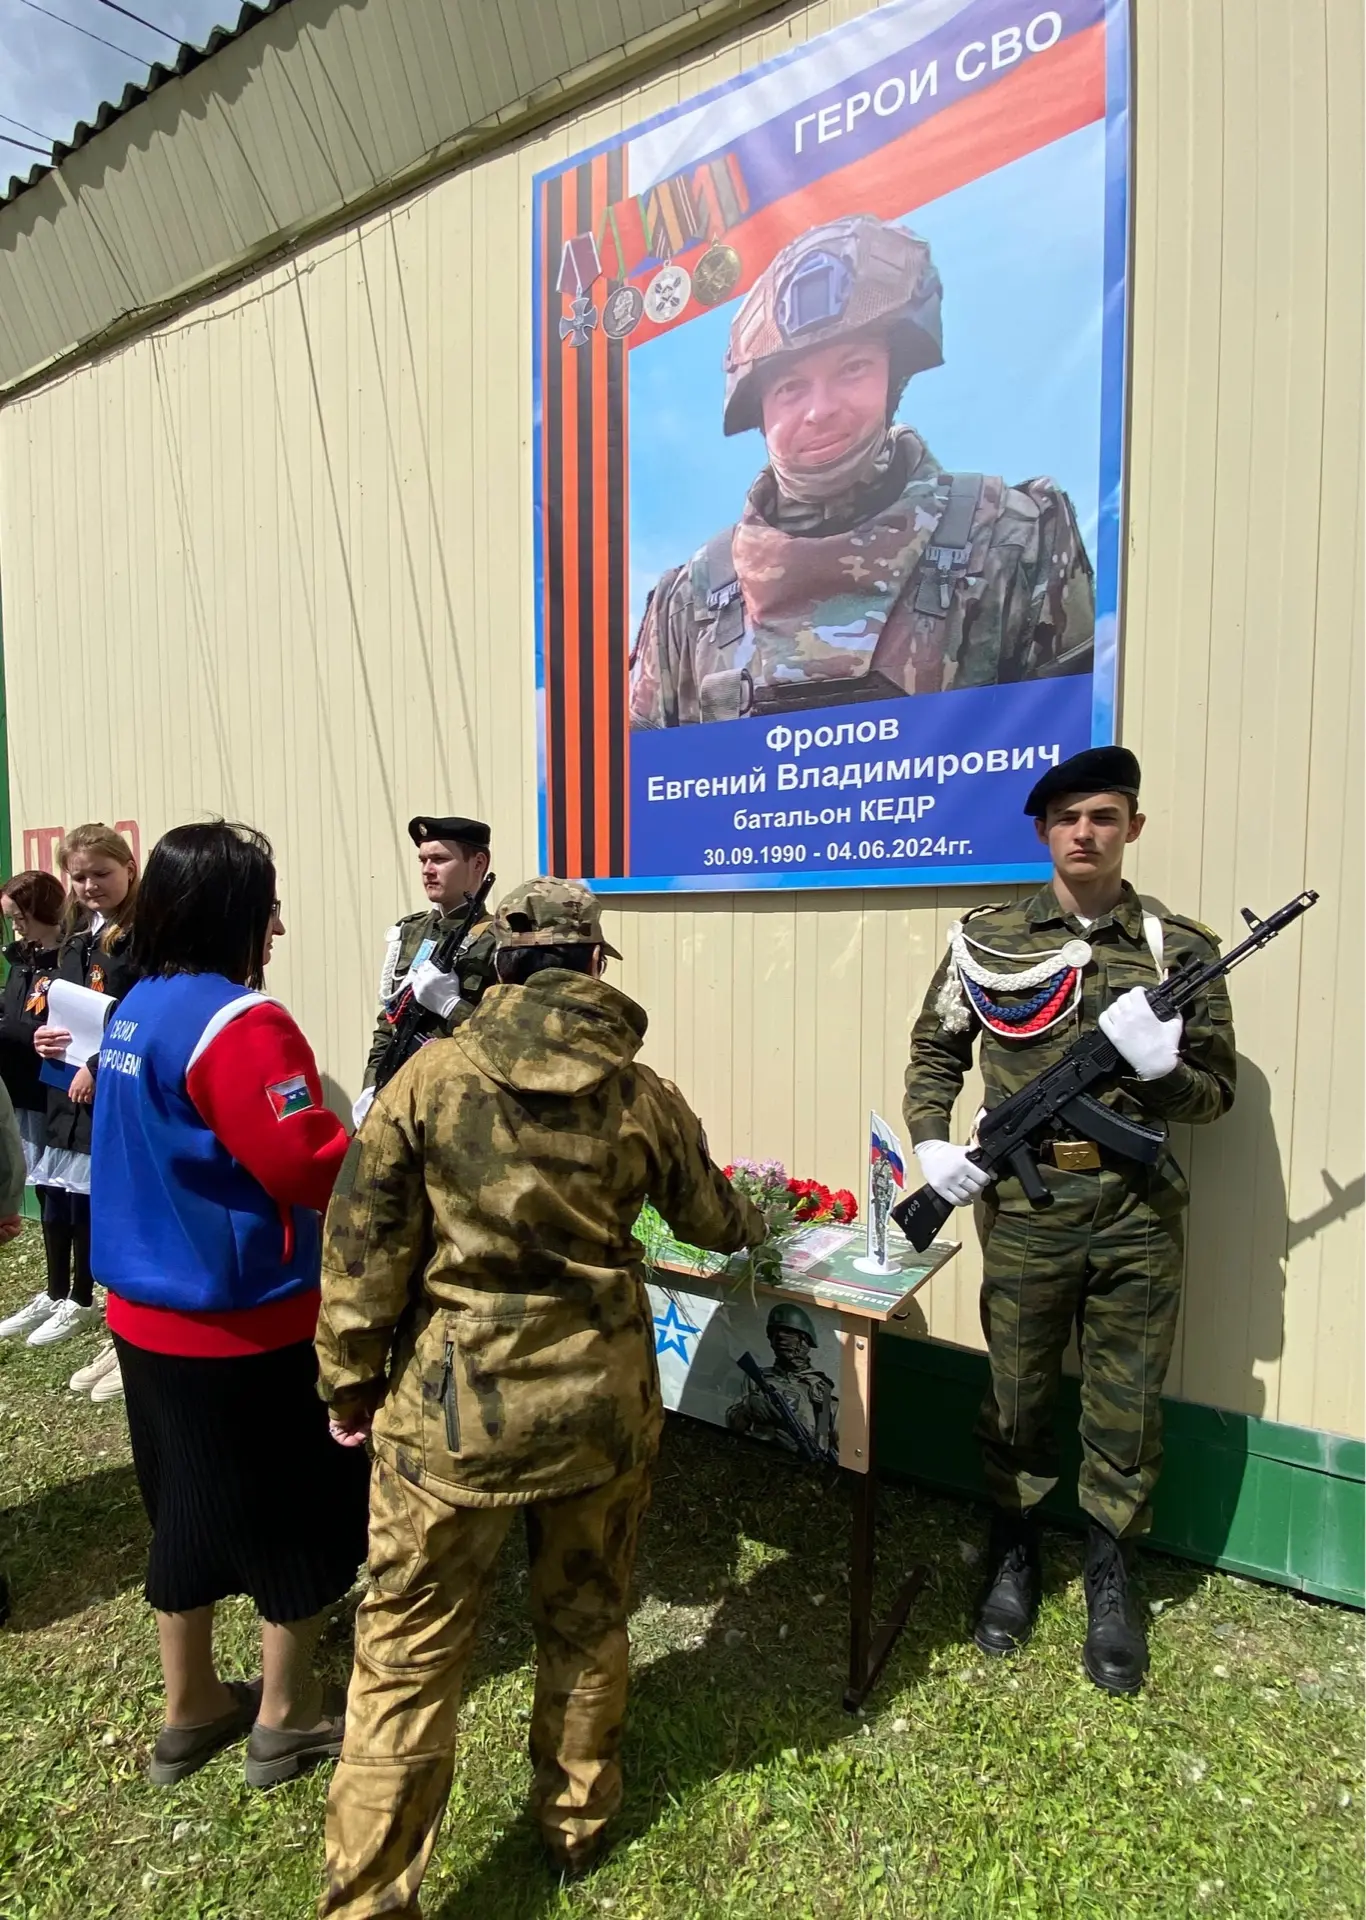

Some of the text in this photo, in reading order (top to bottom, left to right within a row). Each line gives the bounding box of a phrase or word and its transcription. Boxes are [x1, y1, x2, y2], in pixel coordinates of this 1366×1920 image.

[794, 11, 1062, 154] ГЕРОИ СВО
[765, 718, 899, 757] Фролов
[648, 744, 1060, 801] Евгений Владимирович
[733, 795, 936, 830] батальон КЕДР
[703, 844, 807, 866] 30.09.1990
[826, 836, 973, 861] 04.06.2024гг.
